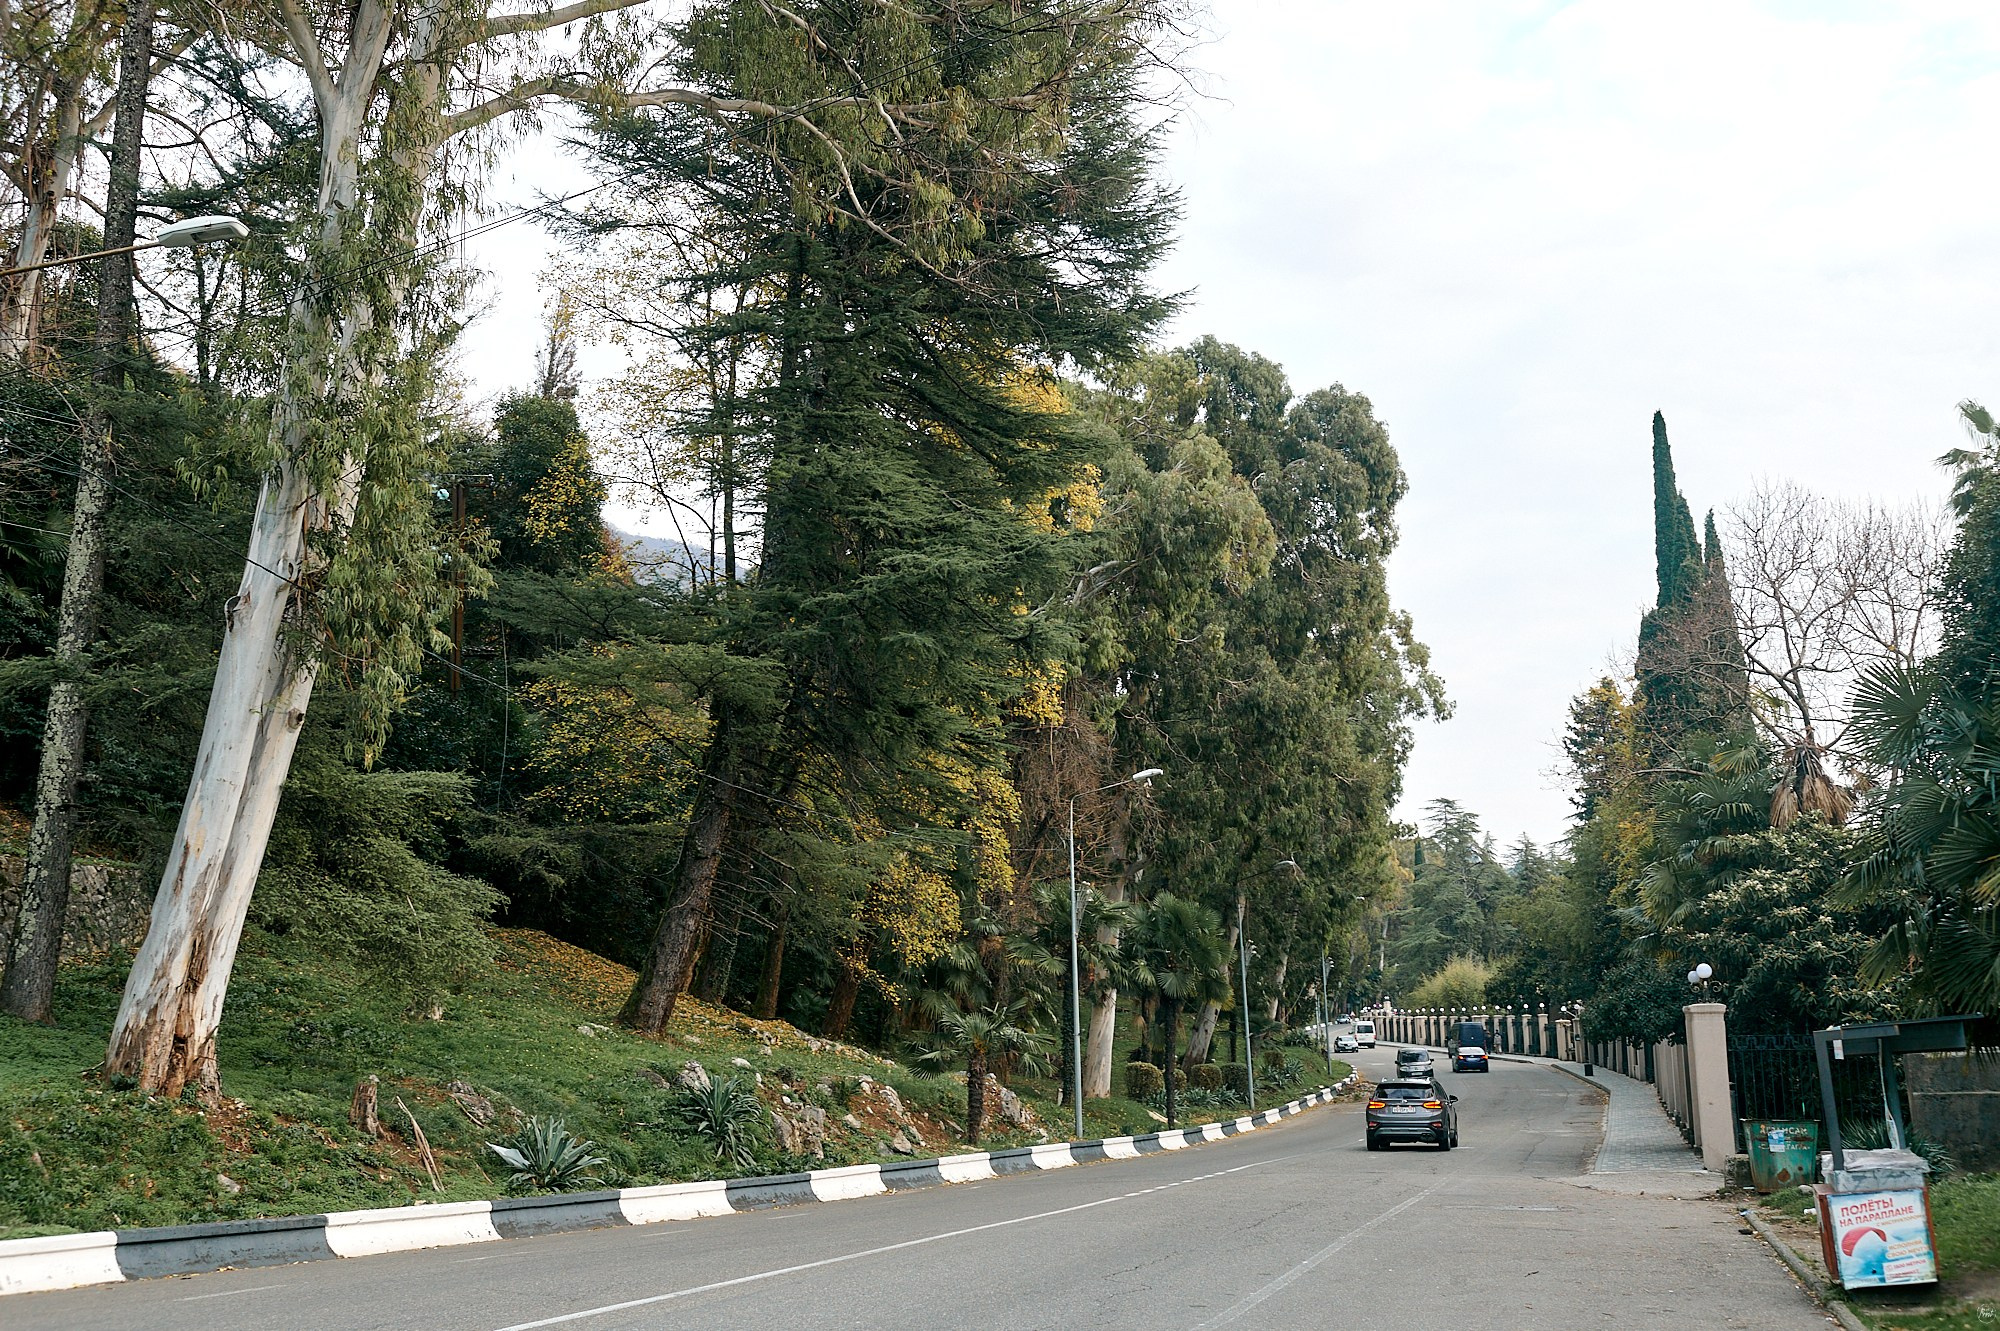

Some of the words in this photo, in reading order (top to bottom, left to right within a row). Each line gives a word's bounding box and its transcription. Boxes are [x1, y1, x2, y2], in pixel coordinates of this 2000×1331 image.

[1840, 1218, 1854, 1227] НА
[1855, 1206, 1914, 1224] ПАРАПЛАНЕ
[1841, 1198, 1893, 1217] ПОЛЁТЫ
